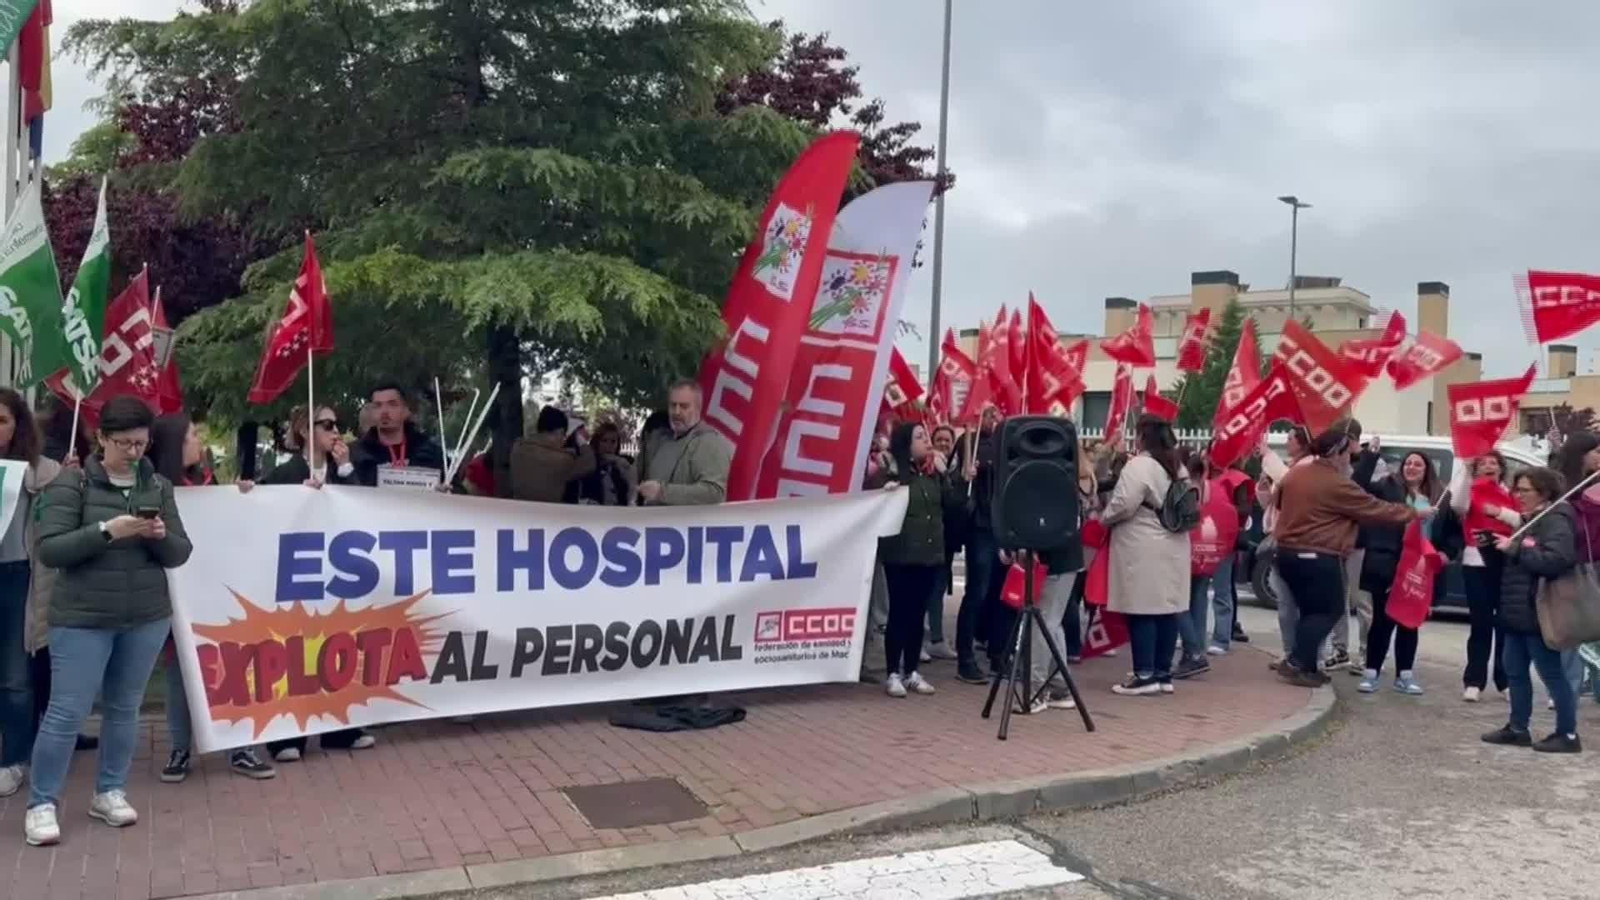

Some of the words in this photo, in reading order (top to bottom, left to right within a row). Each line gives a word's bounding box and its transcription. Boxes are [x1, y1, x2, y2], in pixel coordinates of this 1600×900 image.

[275, 529, 476, 602] ESTE
[496, 523, 818, 592] HOSPITAL
[195, 625, 432, 708] EXPLOTA
[430, 629, 499, 685] AL
[510, 614, 743, 679] PERSONAL
